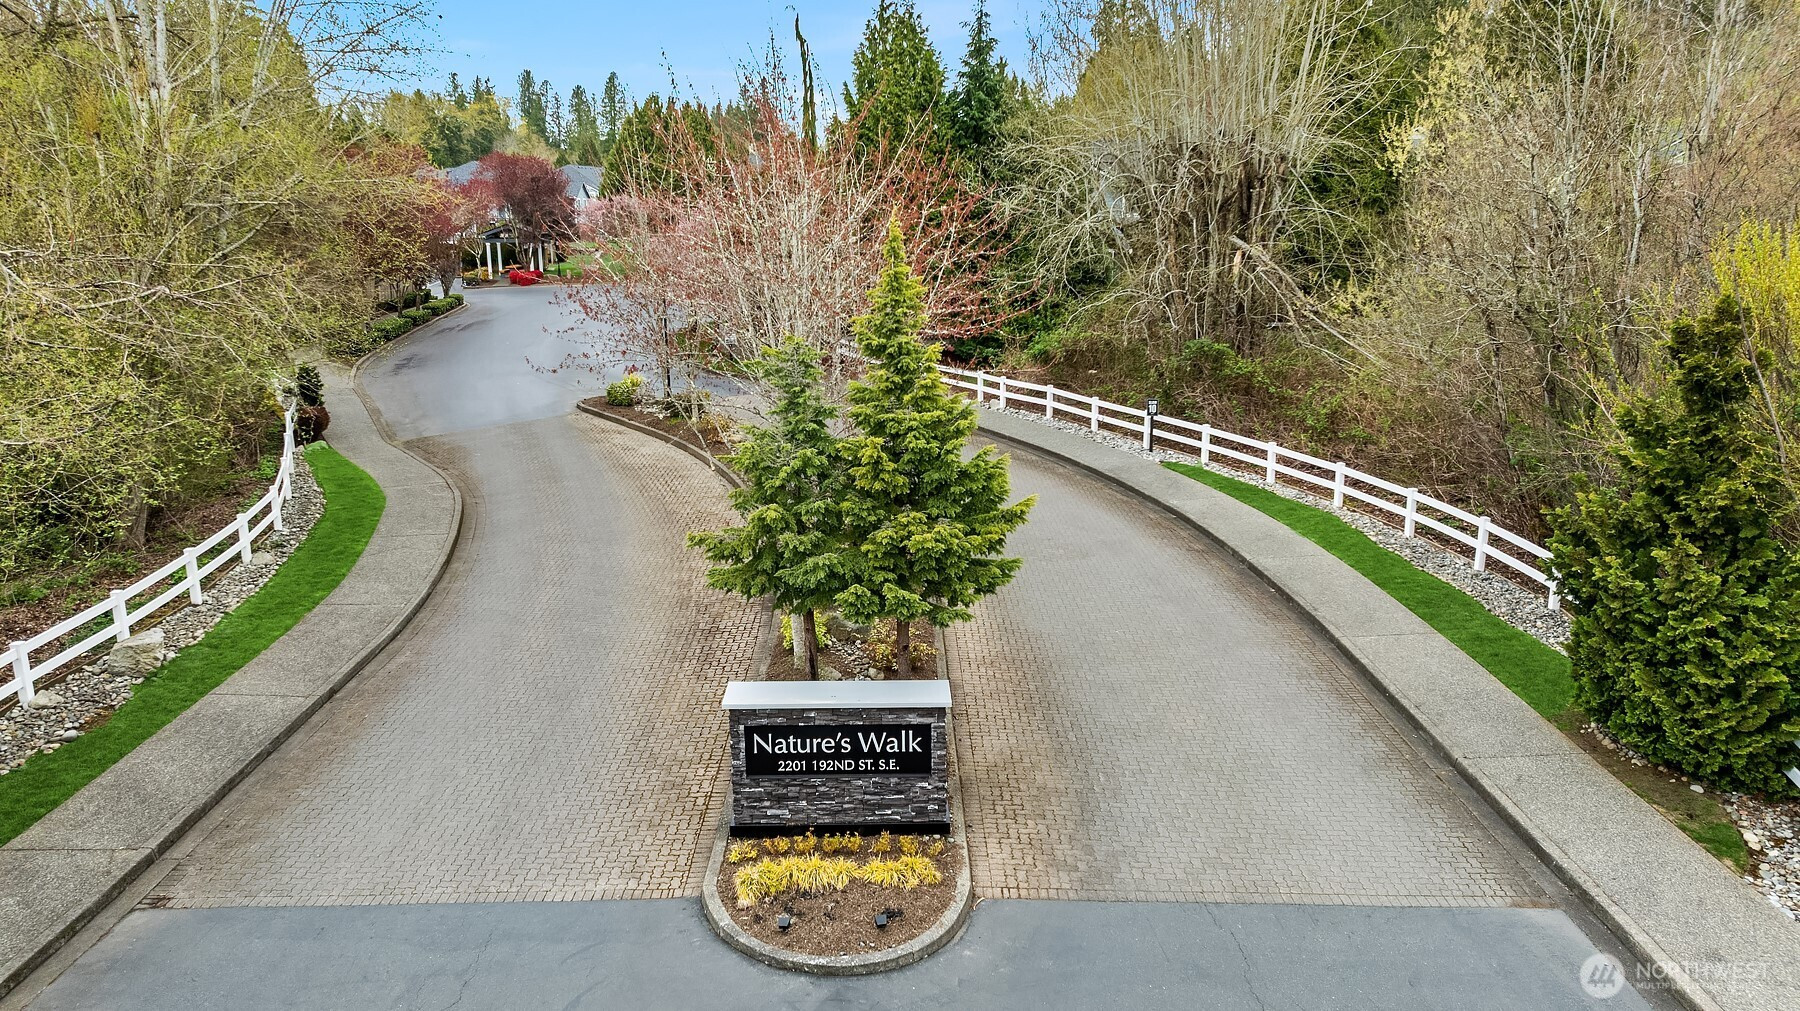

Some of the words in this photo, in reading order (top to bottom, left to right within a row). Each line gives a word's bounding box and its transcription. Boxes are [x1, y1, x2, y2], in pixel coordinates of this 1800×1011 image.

[1148, 404, 1157, 413] 10
[753, 732, 851, 754] Nature's
[857, 730, 922, 753] Walk
[777, 760, 807, 772] 2201
[811, 759, 855, 771] 192ND
[858, 759, 875, 771] ST.
[878, 759, 900, 770] S.E.
